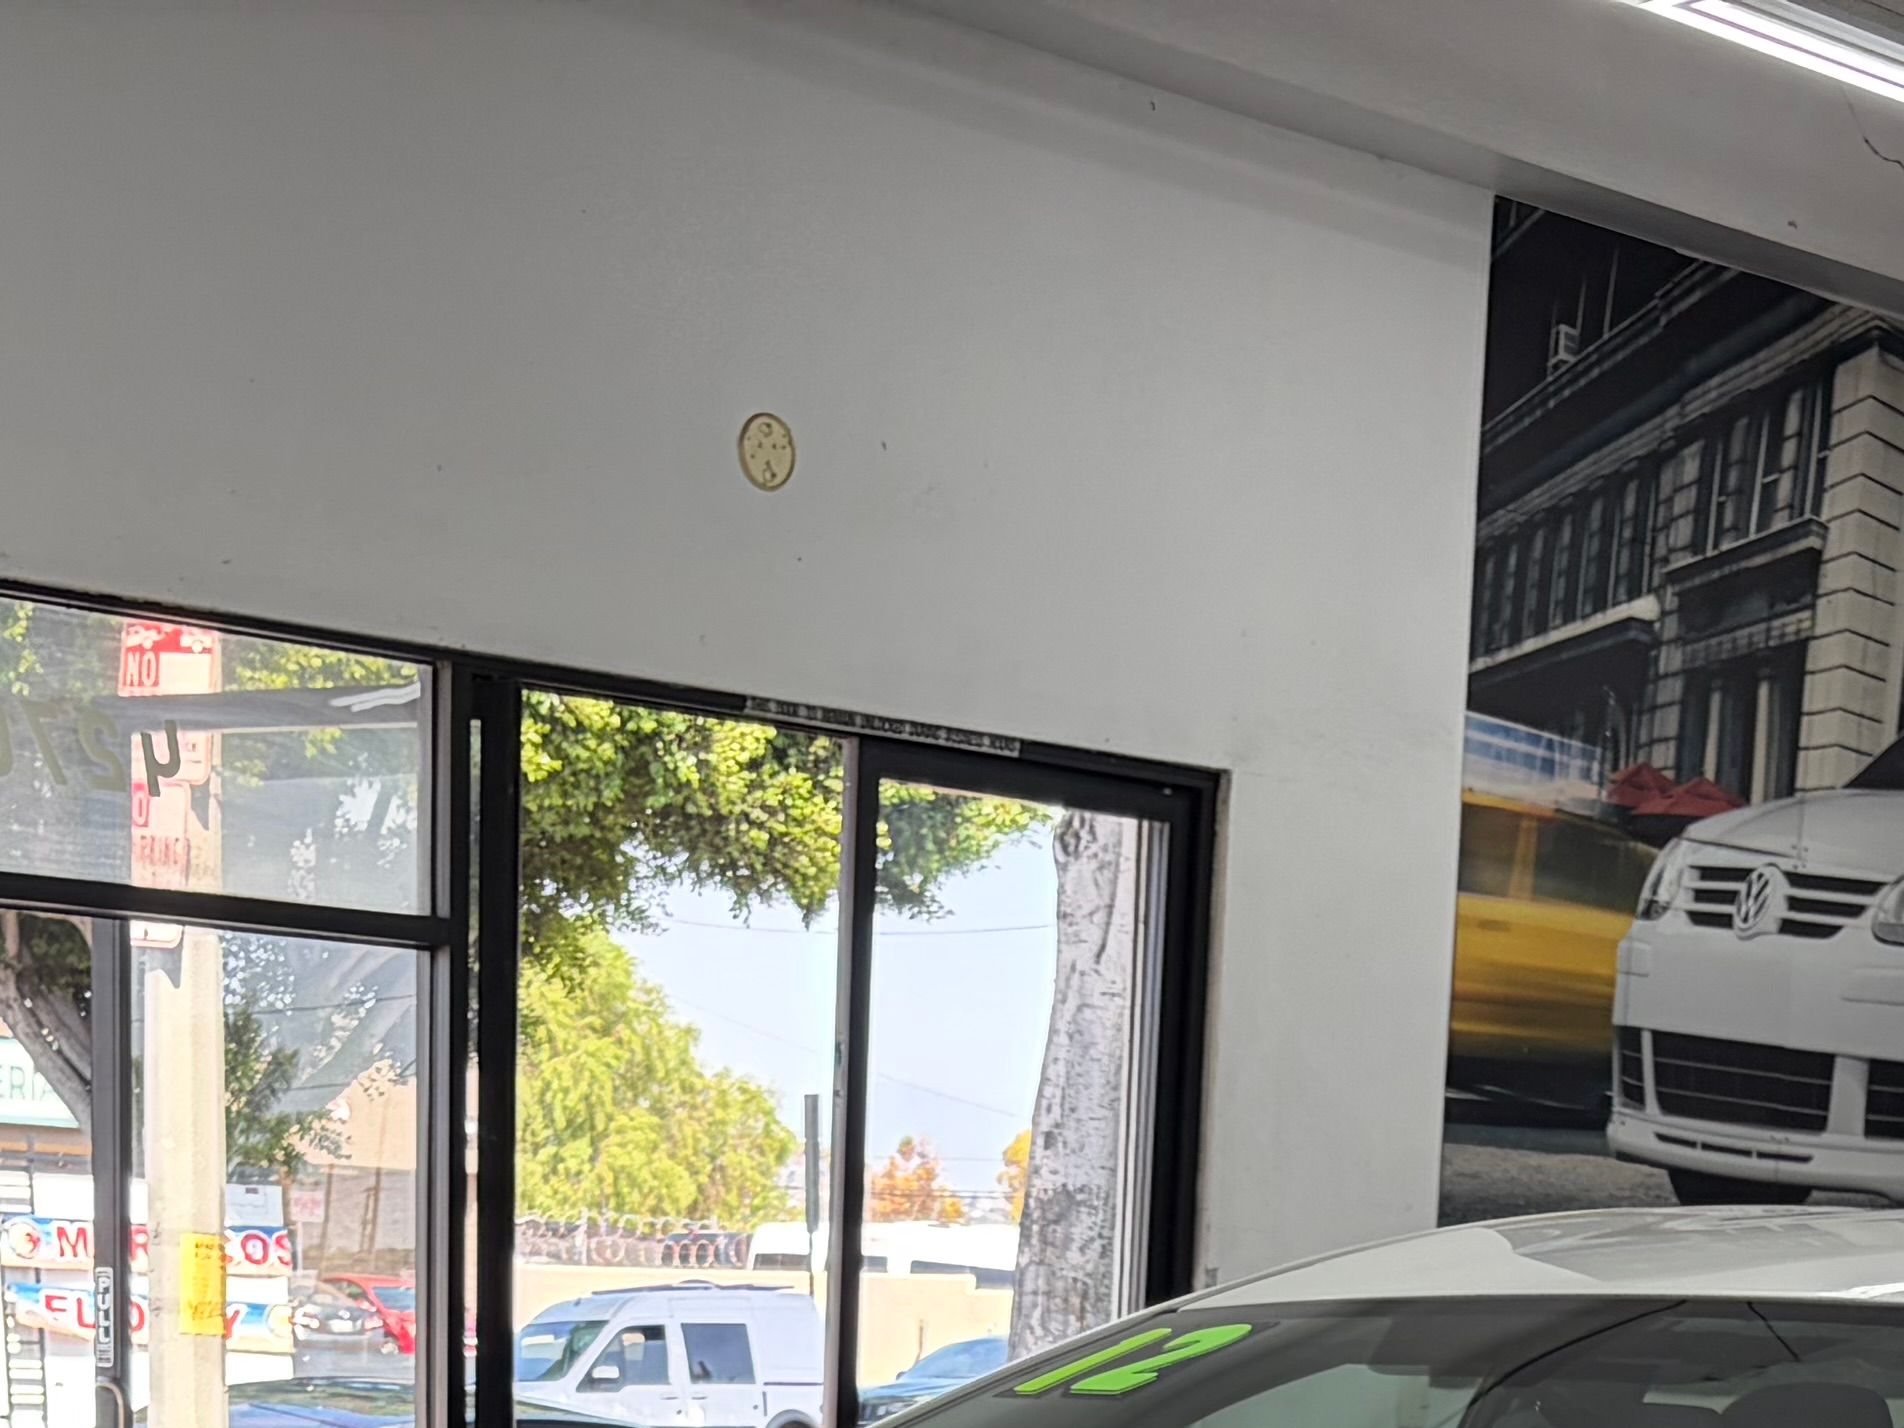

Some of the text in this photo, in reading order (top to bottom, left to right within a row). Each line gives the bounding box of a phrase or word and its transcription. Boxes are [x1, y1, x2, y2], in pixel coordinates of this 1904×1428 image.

[125, 651, 157, 687] NO
[55, 1224, 293, 1266] MROS
[97, 1279, 112, 1343] PULL
[1013, 1323, 1253, 1396] 12
